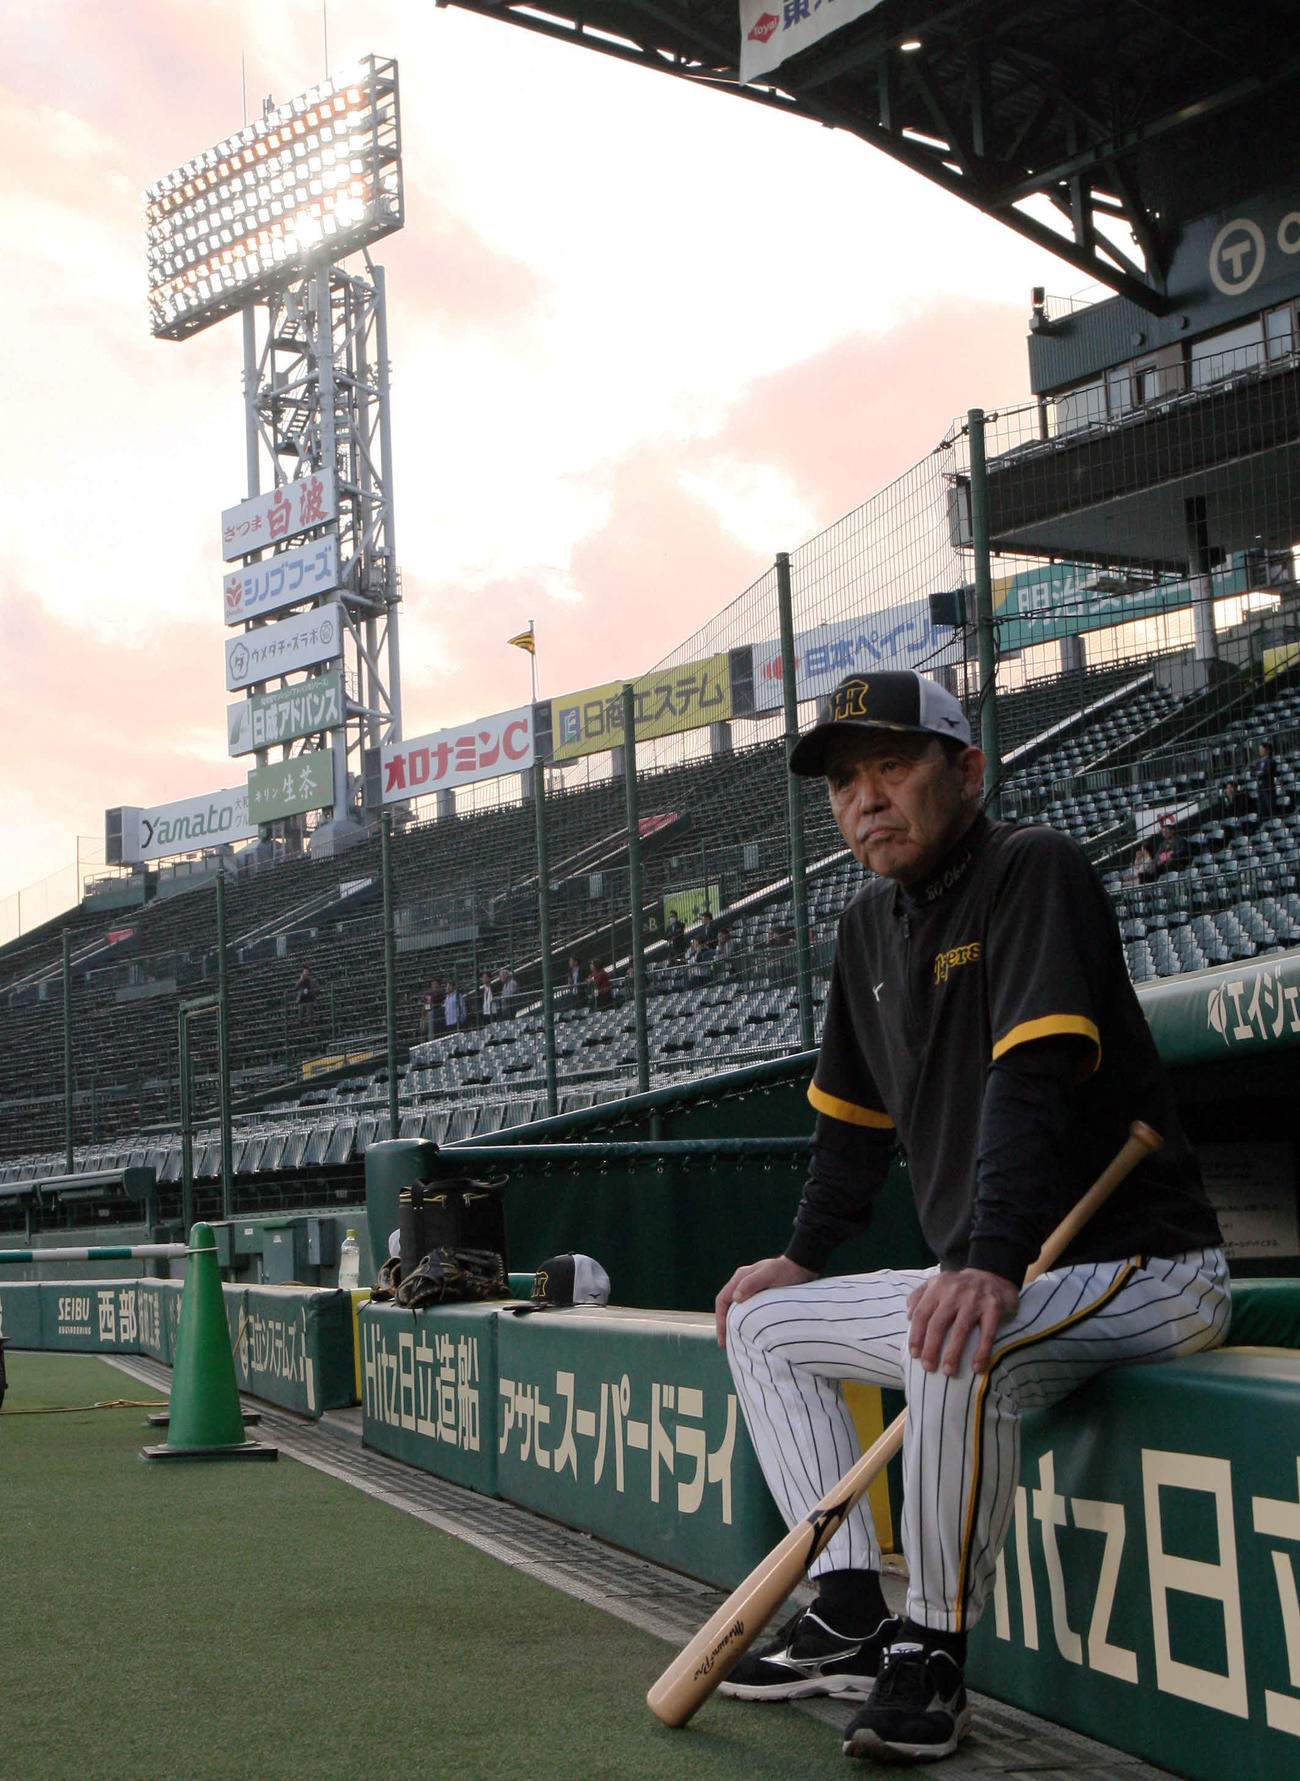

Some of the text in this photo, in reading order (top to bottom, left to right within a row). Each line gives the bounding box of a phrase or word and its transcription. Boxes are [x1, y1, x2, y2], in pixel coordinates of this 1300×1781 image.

[243, 544, 332, 607] シノブフーズ
[251, 628, 320, 663] ウメダチーズラボ
[805, 618, 953, 678] 日本ペイント
[384, 718, 531, 793] オロナミンC
[141, 804, 233, 849] Yamato
[58, 1297, 91, 1321] SEIBU
[499, 1369, 738, 1525] アサヒスーパードライ
